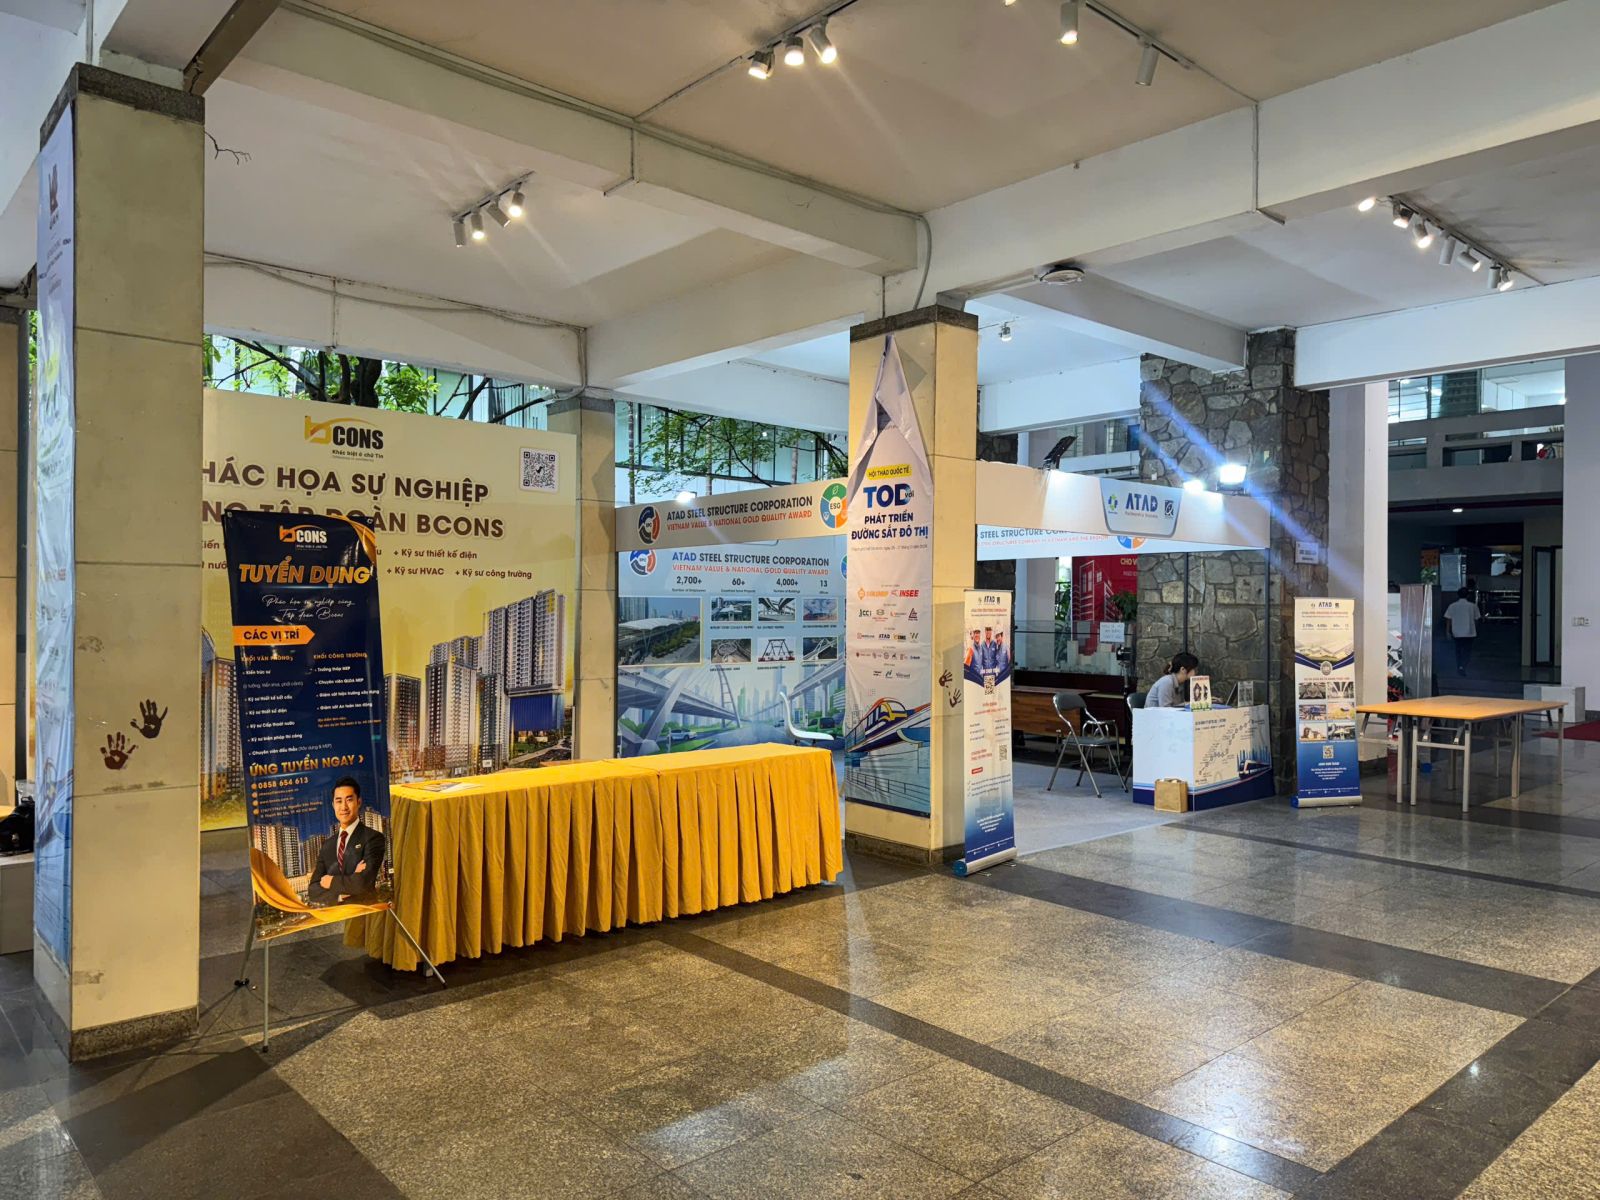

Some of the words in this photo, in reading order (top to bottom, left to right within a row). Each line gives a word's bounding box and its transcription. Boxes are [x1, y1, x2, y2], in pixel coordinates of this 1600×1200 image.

[277, 467, 342, 496] HỌA
[351, 473, 386, 501] SỰ
[395, 477, 489, 507] NGHIỆP
[863, 484, 911, 508] TOD
[1126, 493, 1158, 512] ATAD
[667, 510, 685, 521] ATAD
[688, 508, 706, 519] STEEL
[707, 502, 749, 518] STRUCTURE
[751, 496, 812, 513] CORPORATION
[829, 502, 841, 510] ESG
[667, 522, 690, 532] VIETNAM
[691, 520, 708, 529] VALUE
[714, 517, 742, 528] NATIONAL
[743, 515, 760, 524] GOLD
[762, 513, 787, 522] QUALITY
[788, 510, 812, 520] AWARD
[864, 512, 886, 524] PHÁT
[888, 509, 914, 523] TRIỂN
[417, 514, 504, 538] BCONS
[851, 527, 880, 540] ĐƯỜNG
[881, 524, 897, 538] SẮT
[899, 525, 912, 538] ĐÔ
[914, 527, 929, 539] THỊ
[981, 530, 999, 539] STEEL
[1001, 528, 1043, 538] STRUCTURE
[200, 539, 220, 549] iến
[401, 548, 413, 558] Kỹ
[426, 548, 446, 558] thiết
[447, 549, 458, 558] kế
[459, 551, 478, 561] điện
[672, 552, 697, 562] ATAD
[700, 553, 722, 563] STEEL
[725, 554, 771, 564] STRUCTURE
[772, 556, 830, 567] CORPORATION
[1120, 558, 1132, 566] CHO
[239, 556, 304, 584] TUYỂN
[310, 565, 371, 588] DỤNG
[394, 566, 406, 576] Kỹ
[420, 568, 445, 576] HVAC
[462, 569, 473, 578] Kỹ
[485, 569, 506, 579] công
[507, 570, 533, 580] trường
[672, 564, 702, 572] VIETNAM
[704, 565, 723, 573] VALUE
[732, 566, 763, 574] NATIONAL
[783, 567, 807, 575] QUALITY
[808, 568, 829, 576] AWARD
[676, 576, 702, 586] 2,700+
[732, 578, 746, 586] 60+
[776, 578, 799, 588] 4,000+
[820, 580, 828, 588] 13
[243, 629, 268, 640] CÁC
[270, 630, 282, 642] VỊ
[284, 629, 299, 640] TRÍ
[313, 652, 328, 660] KHỐI
[346, 651, 367, 659] TRƯỜNG
[250, 762, 279, 776] ỨNG
[281, 754, 319, 773] TUYỂN
[322, 756, 355, 769] NGAY
